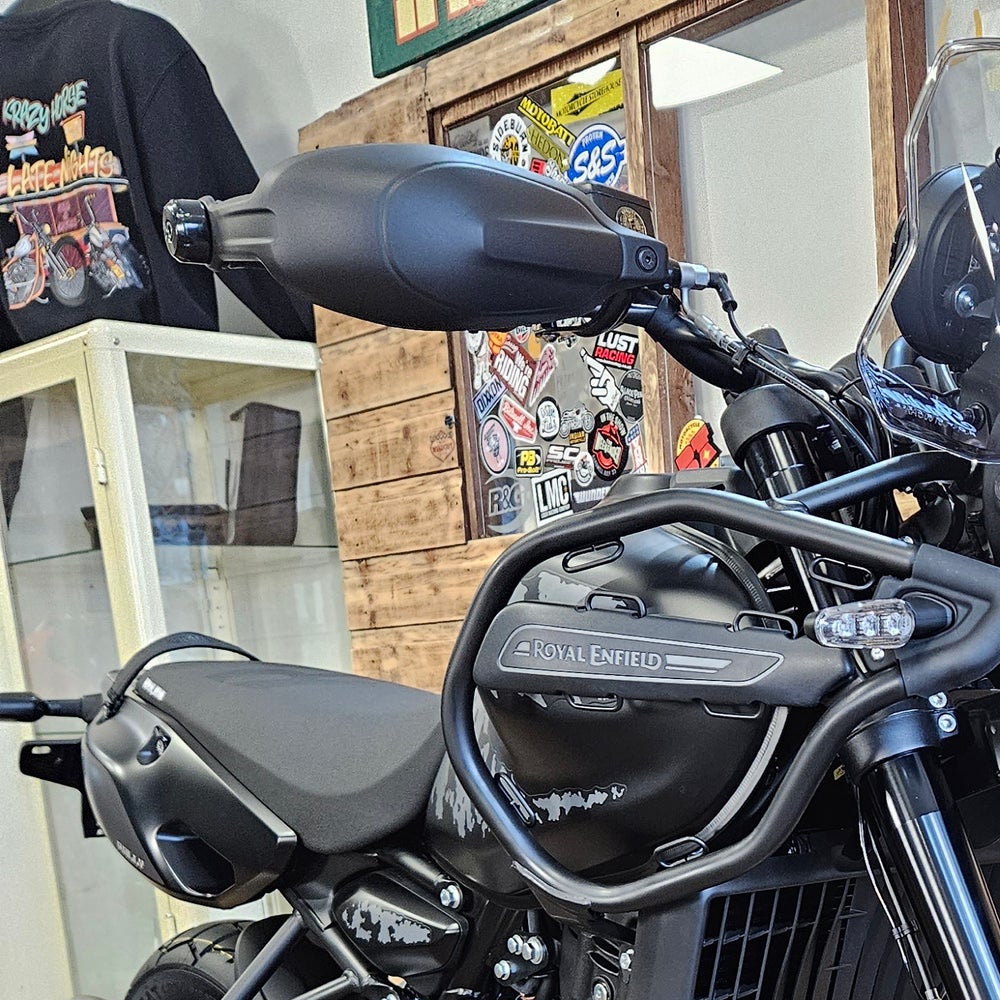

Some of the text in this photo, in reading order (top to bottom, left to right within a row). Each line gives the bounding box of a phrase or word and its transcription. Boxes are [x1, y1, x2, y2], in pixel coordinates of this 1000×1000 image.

[2, 79, 88, 134] KRAZY HORSE
[519, 96, 576, 146] MOTOBATT
[492, 118, 528, 153] SIDEBURN
[7, 159, 56, 197] LATE
[572, 139, 621, 183] S&S
[594, 346, 636, 365] RACING
[597, 331, 639, 354] LUST
[493, 349, 530, 402] RIDING
[519, 450, 536, 466] PB
[537, 474, 570, 513] LMC
[533, 639, 663, 671] ROYAL ENFIELD
